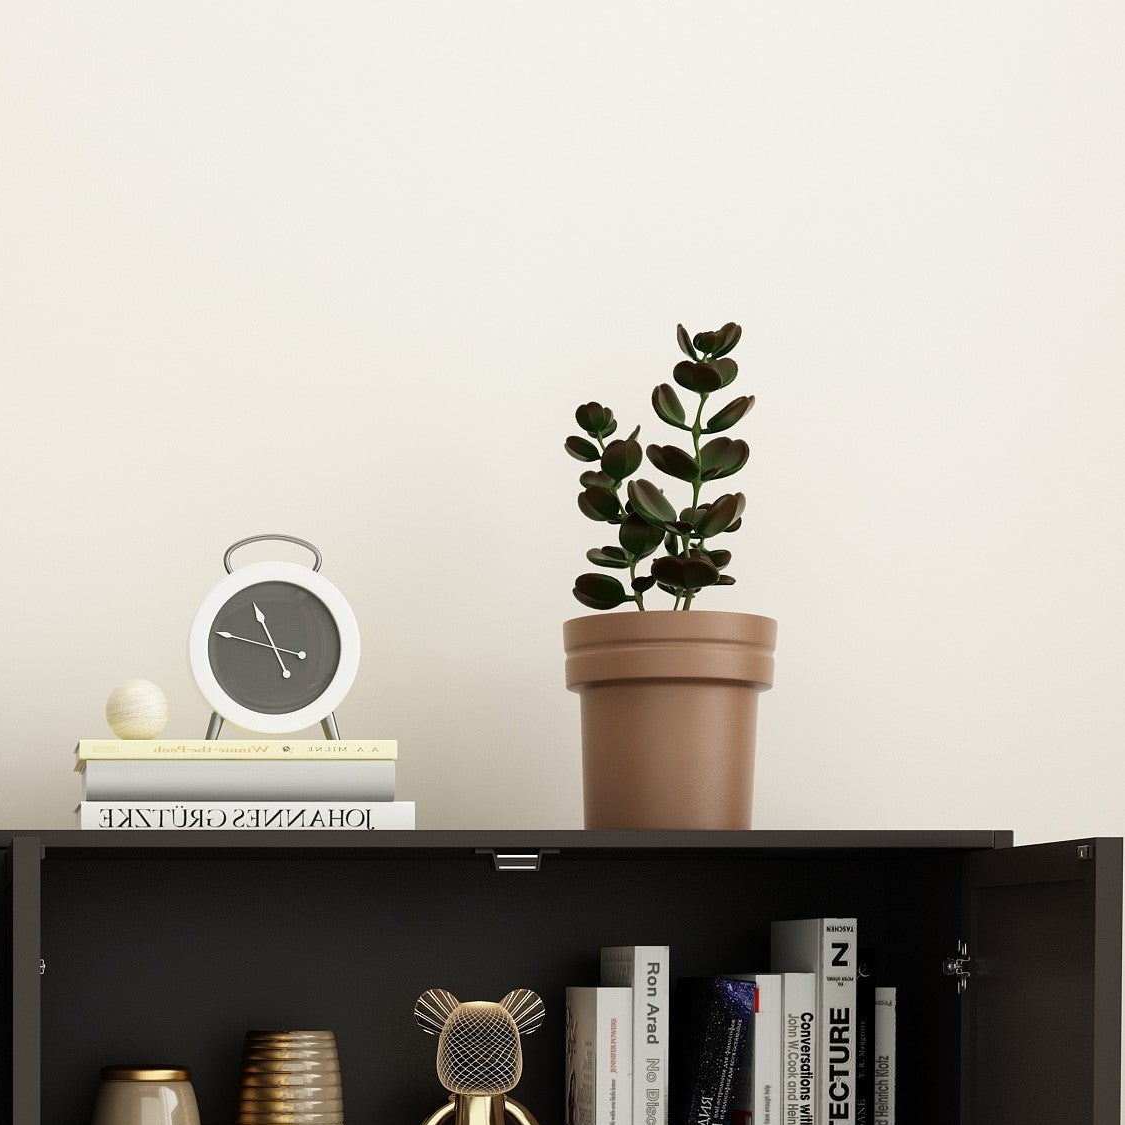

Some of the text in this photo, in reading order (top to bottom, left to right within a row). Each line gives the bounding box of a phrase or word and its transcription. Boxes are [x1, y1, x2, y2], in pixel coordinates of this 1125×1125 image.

[646, 962, 660, 1044] Ron Arad
[787, 1013, 799, 1038] John
[646, 1058, 660, 1083] No
[787, 1040, 799, 1079] W.Cook
[800, 1012, 814, 1101] Conversations
[876, 1055, 889, 1077] Klotz
[787, 1081, 798, 1101] and
[876, 1079, 889, 1118] Heinrich
